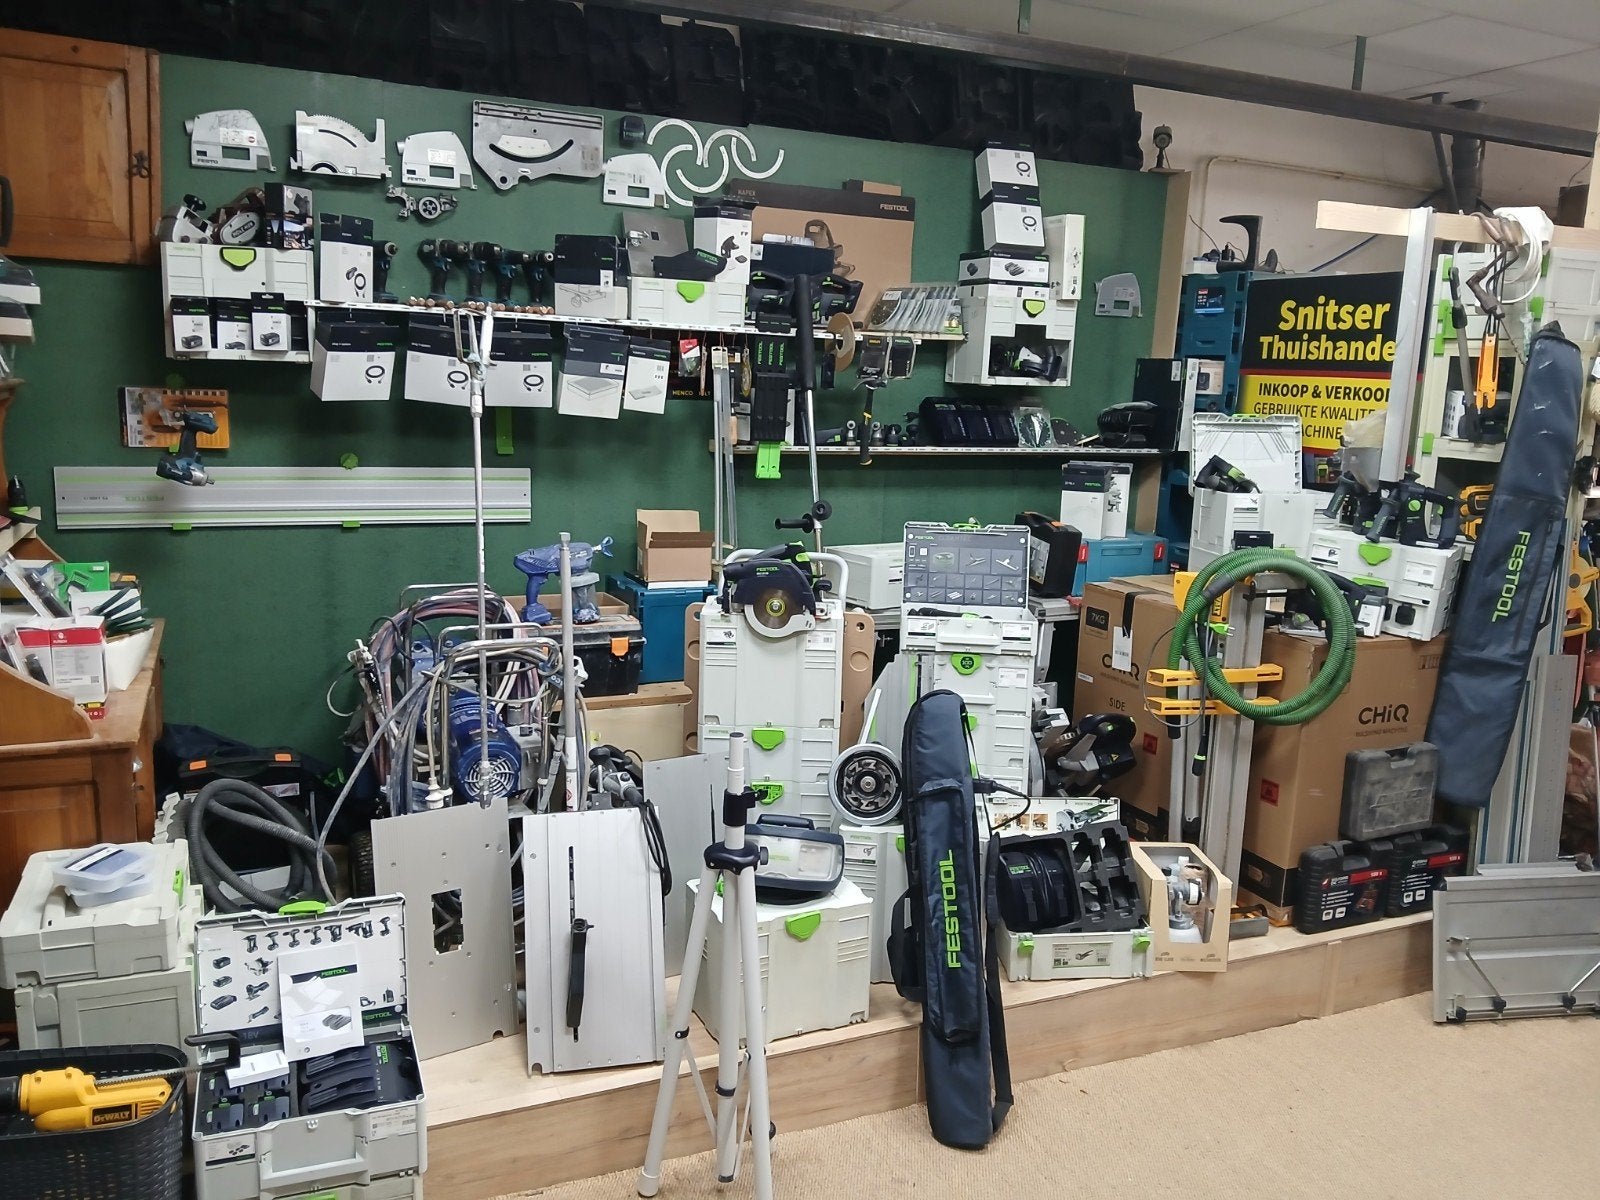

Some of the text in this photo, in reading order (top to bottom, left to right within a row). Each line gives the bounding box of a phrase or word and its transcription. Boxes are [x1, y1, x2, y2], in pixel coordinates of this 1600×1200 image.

[879, 203, 909, 212] FESTOOL
[1278, 295, 1391, 331] Snitser
[1258, 382, 1309, 398] INKOOP
[1311, 384, 1322, 399] &
[1253, 402, 1317, 418] GEBRUIKTE
[1491, 530, 1531, 623] FESTOOL
[1090, 612, 1107, 625] 7KG
[1109, 697, 1126, 712] SIDE
[1358, 703, 1410, 725] CHiQ
[939, 849, 962, 969] FESTOOL
[321, 968, 349, 977] FESTOOL
